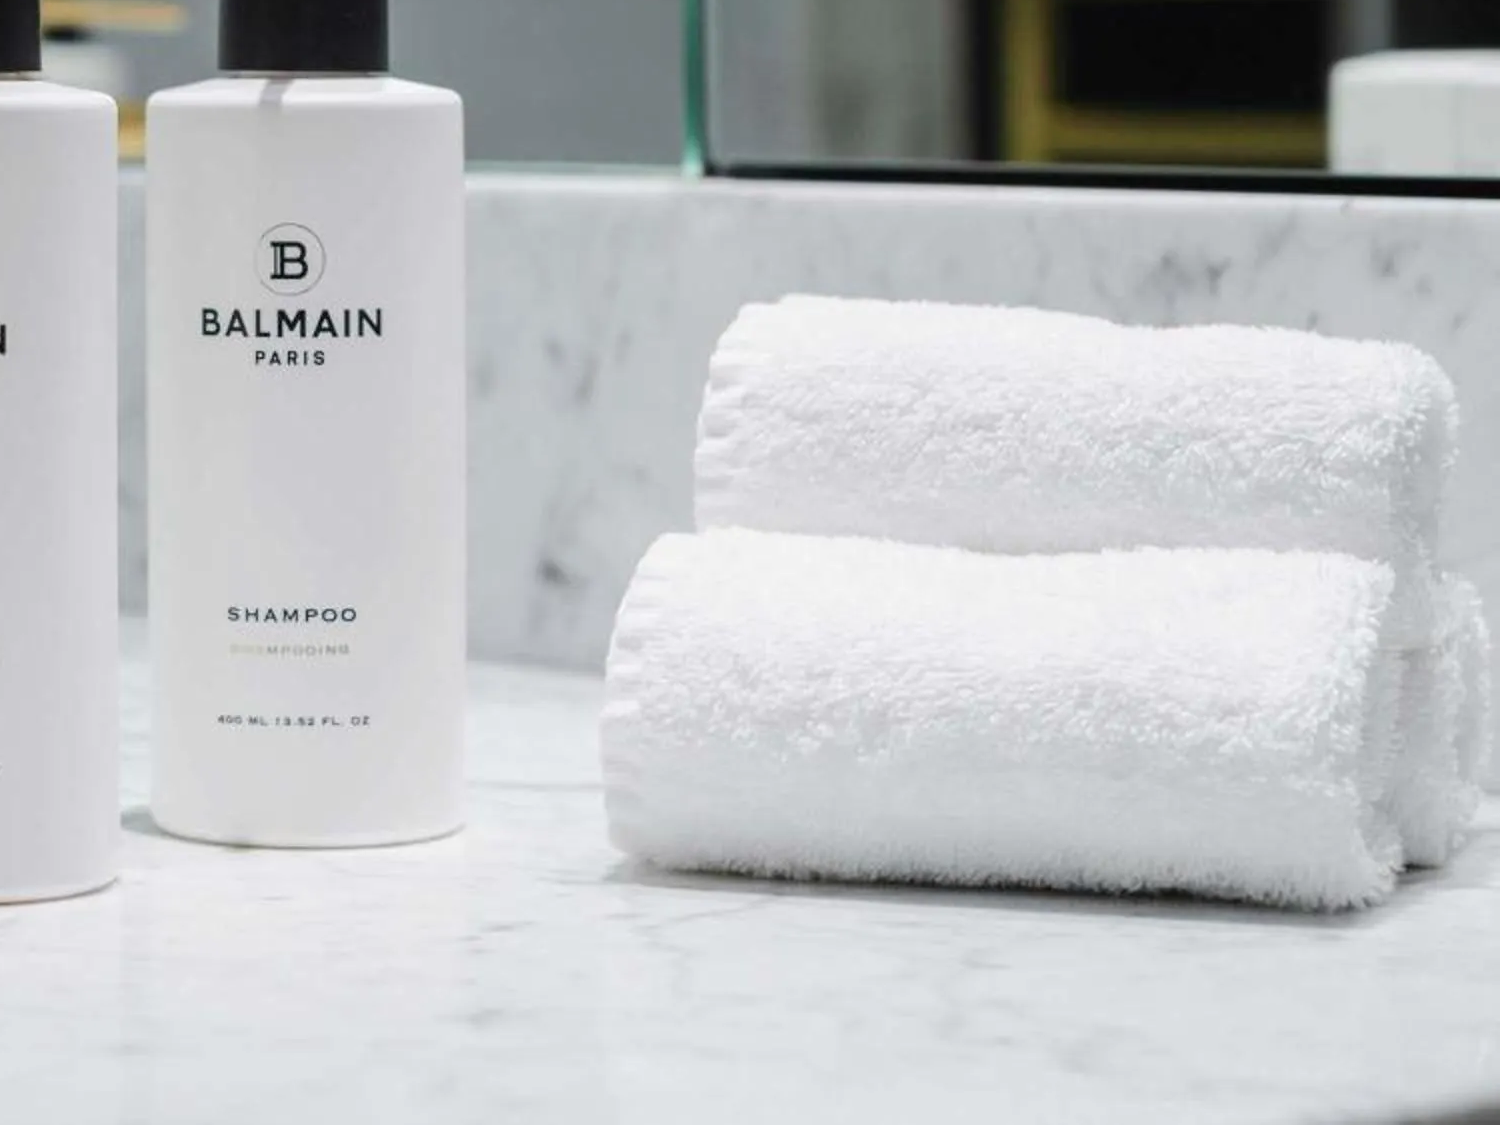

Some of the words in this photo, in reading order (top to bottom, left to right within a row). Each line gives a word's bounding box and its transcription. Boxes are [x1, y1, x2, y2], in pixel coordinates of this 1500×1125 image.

[270, 241, 308, 280] B
[201, 308, 382, 338] BALMAIN
[255, 350, 325, 366] PARIS
[227, 607, 357, 623] SHAMPOO
[217, 714, 243, 725] 400
